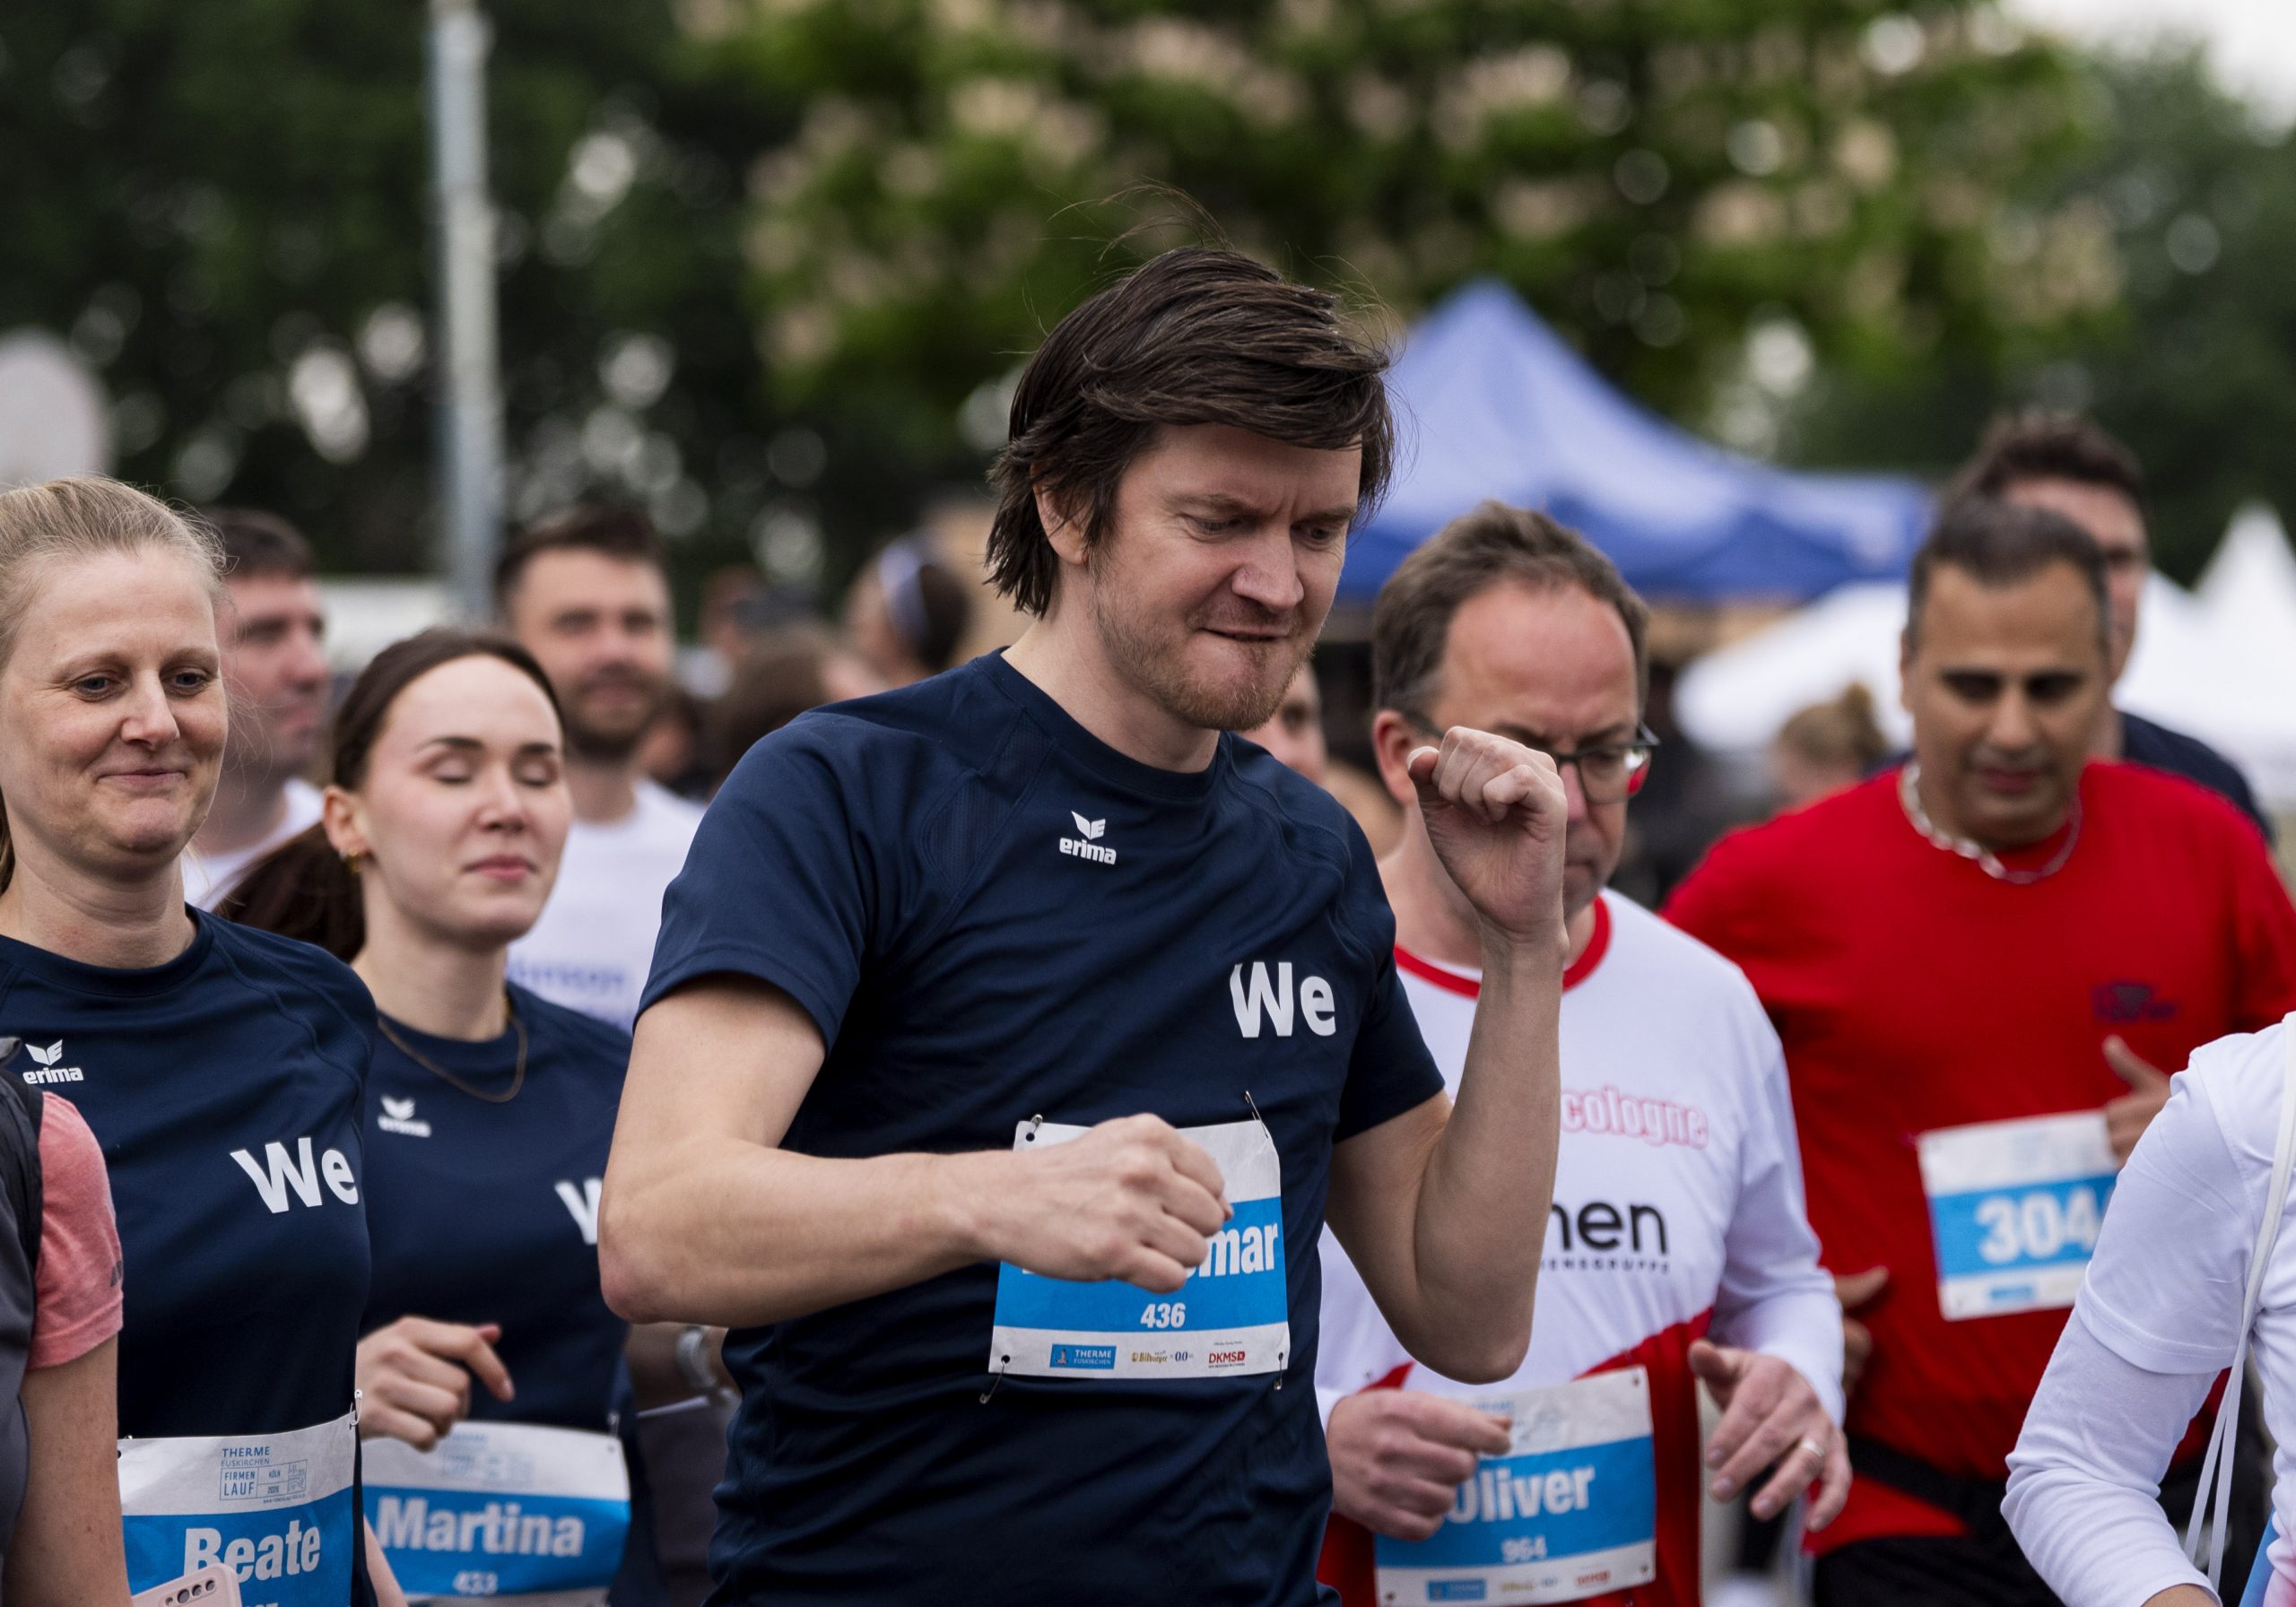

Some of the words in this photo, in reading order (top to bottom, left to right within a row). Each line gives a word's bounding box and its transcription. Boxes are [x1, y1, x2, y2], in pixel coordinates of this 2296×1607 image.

[1059, 837, 1117, 865] erima
[1230, 961, 1336, 1038] We
[22, 1066, 84, 1085] erima
[1561, 1084, 1709, 1150] cologne
[230, 1137, 359, 1214] We
[1977, 1186, 2108, 1263] 304
[1141, 1302, 1187, 1328] 436
[1075, 1349, 1112, 1358] THERME
[1208, 1351, 1238, 1363] DKMS
[222, 1446, 270, 1457] THERME
[222, 1458, 270, 1467] EUSKIRCHEN
[223, 1481, 255, 1497] LAUF
[224, 1471, 256, 1481] FIRMEN
[1447, 1465, 1596, 1524] Oliver
[374, 1495, 586, 1558] Martina
[184, 1519, 321, 1584] Beate
